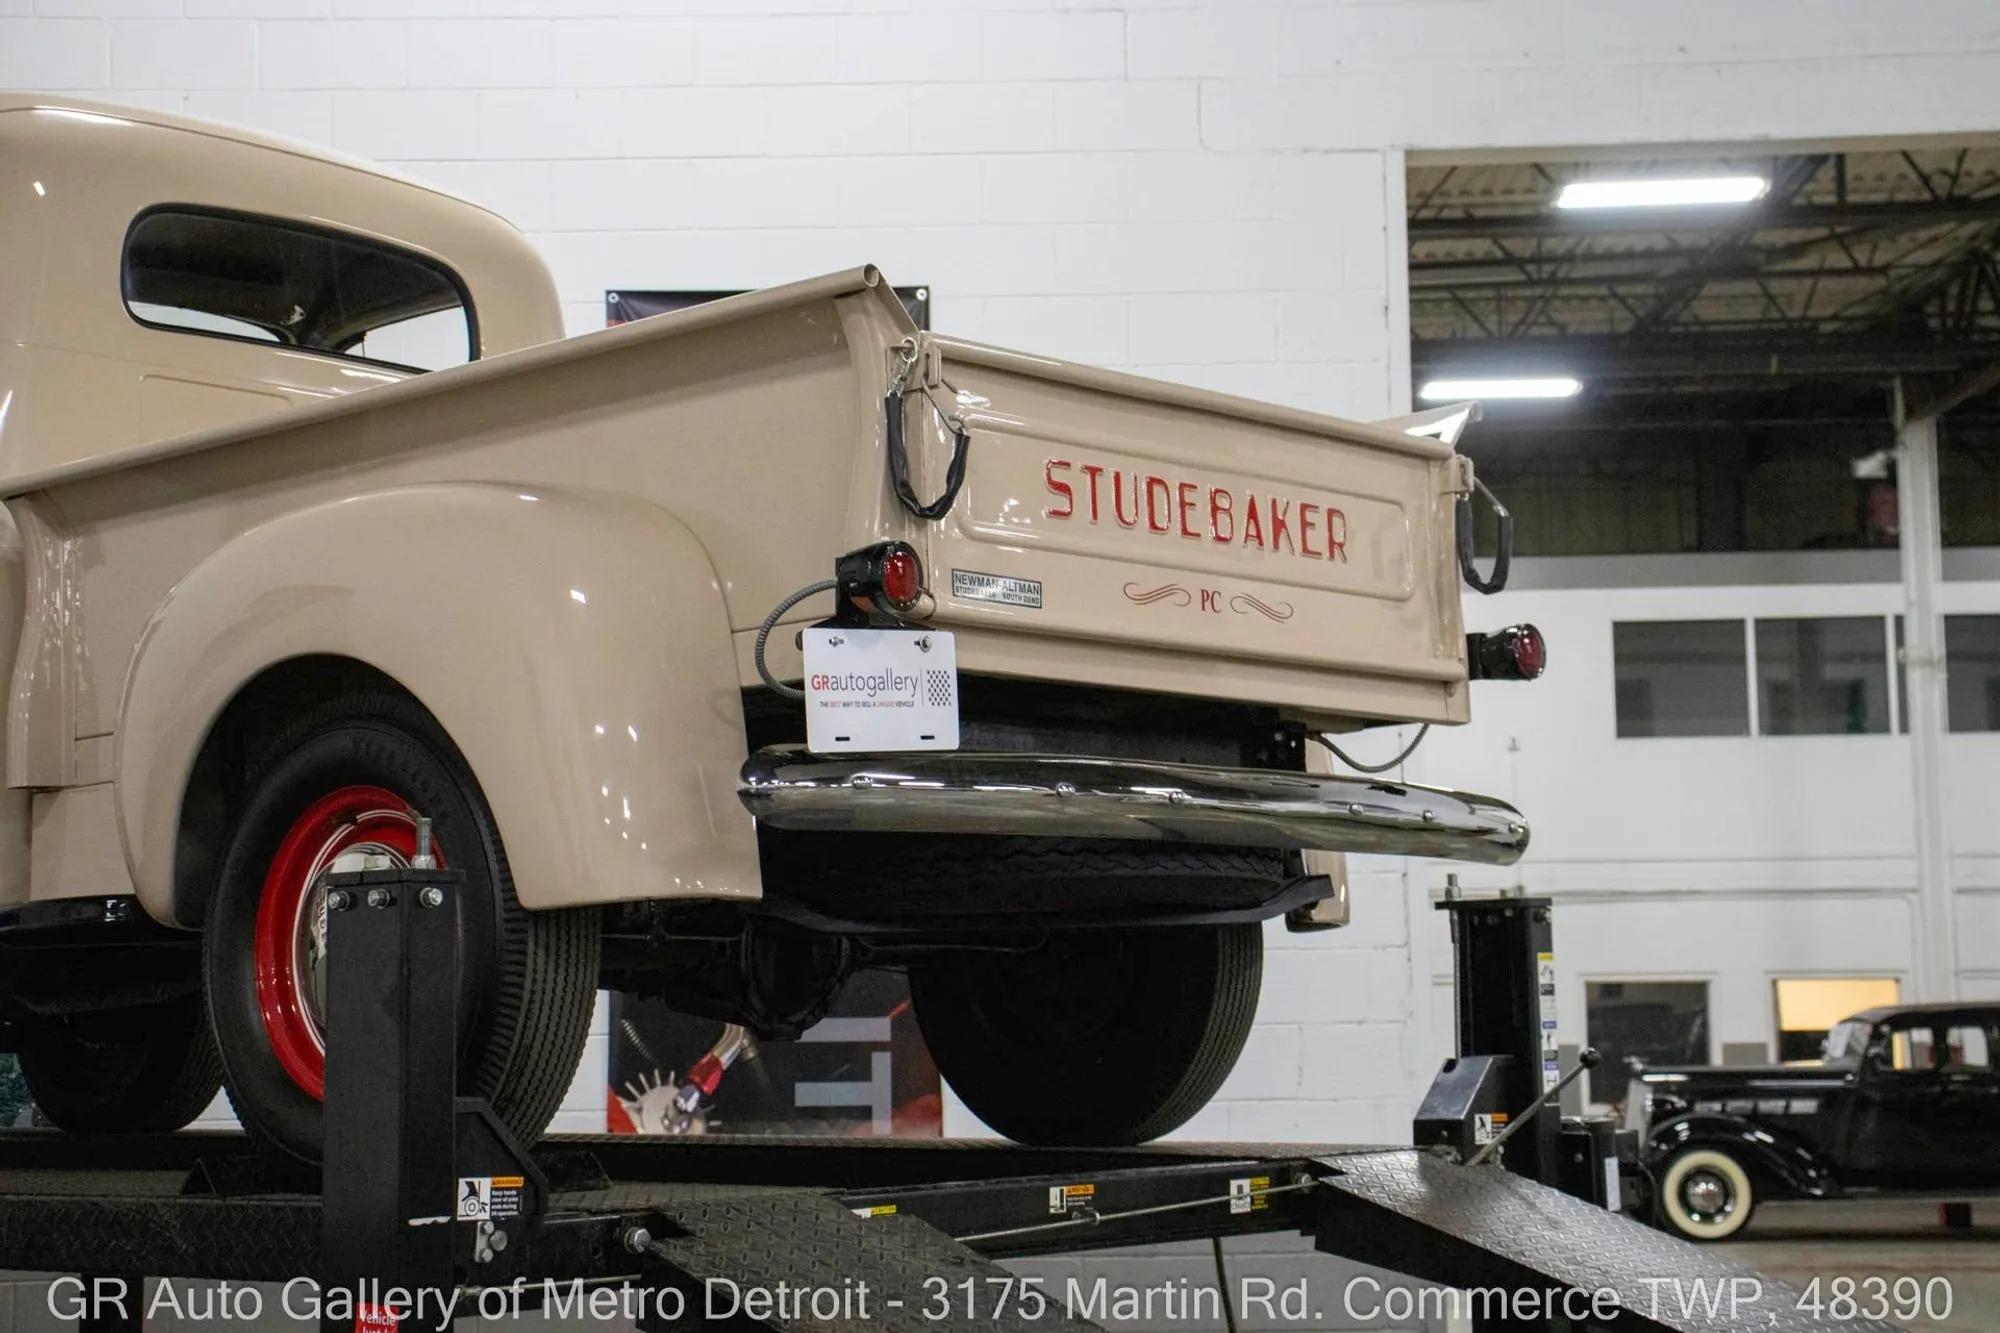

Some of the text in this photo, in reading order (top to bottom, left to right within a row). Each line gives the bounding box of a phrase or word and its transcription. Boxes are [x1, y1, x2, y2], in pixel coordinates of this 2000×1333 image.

[1044, 457, 1348, 563] STUDEBAKER
[954, 572, 1040, 595] NEWMAN-ALTMAN
[1200, 588, 1222, 614] PC
[811, 667, 918, 698] GRautogallery
